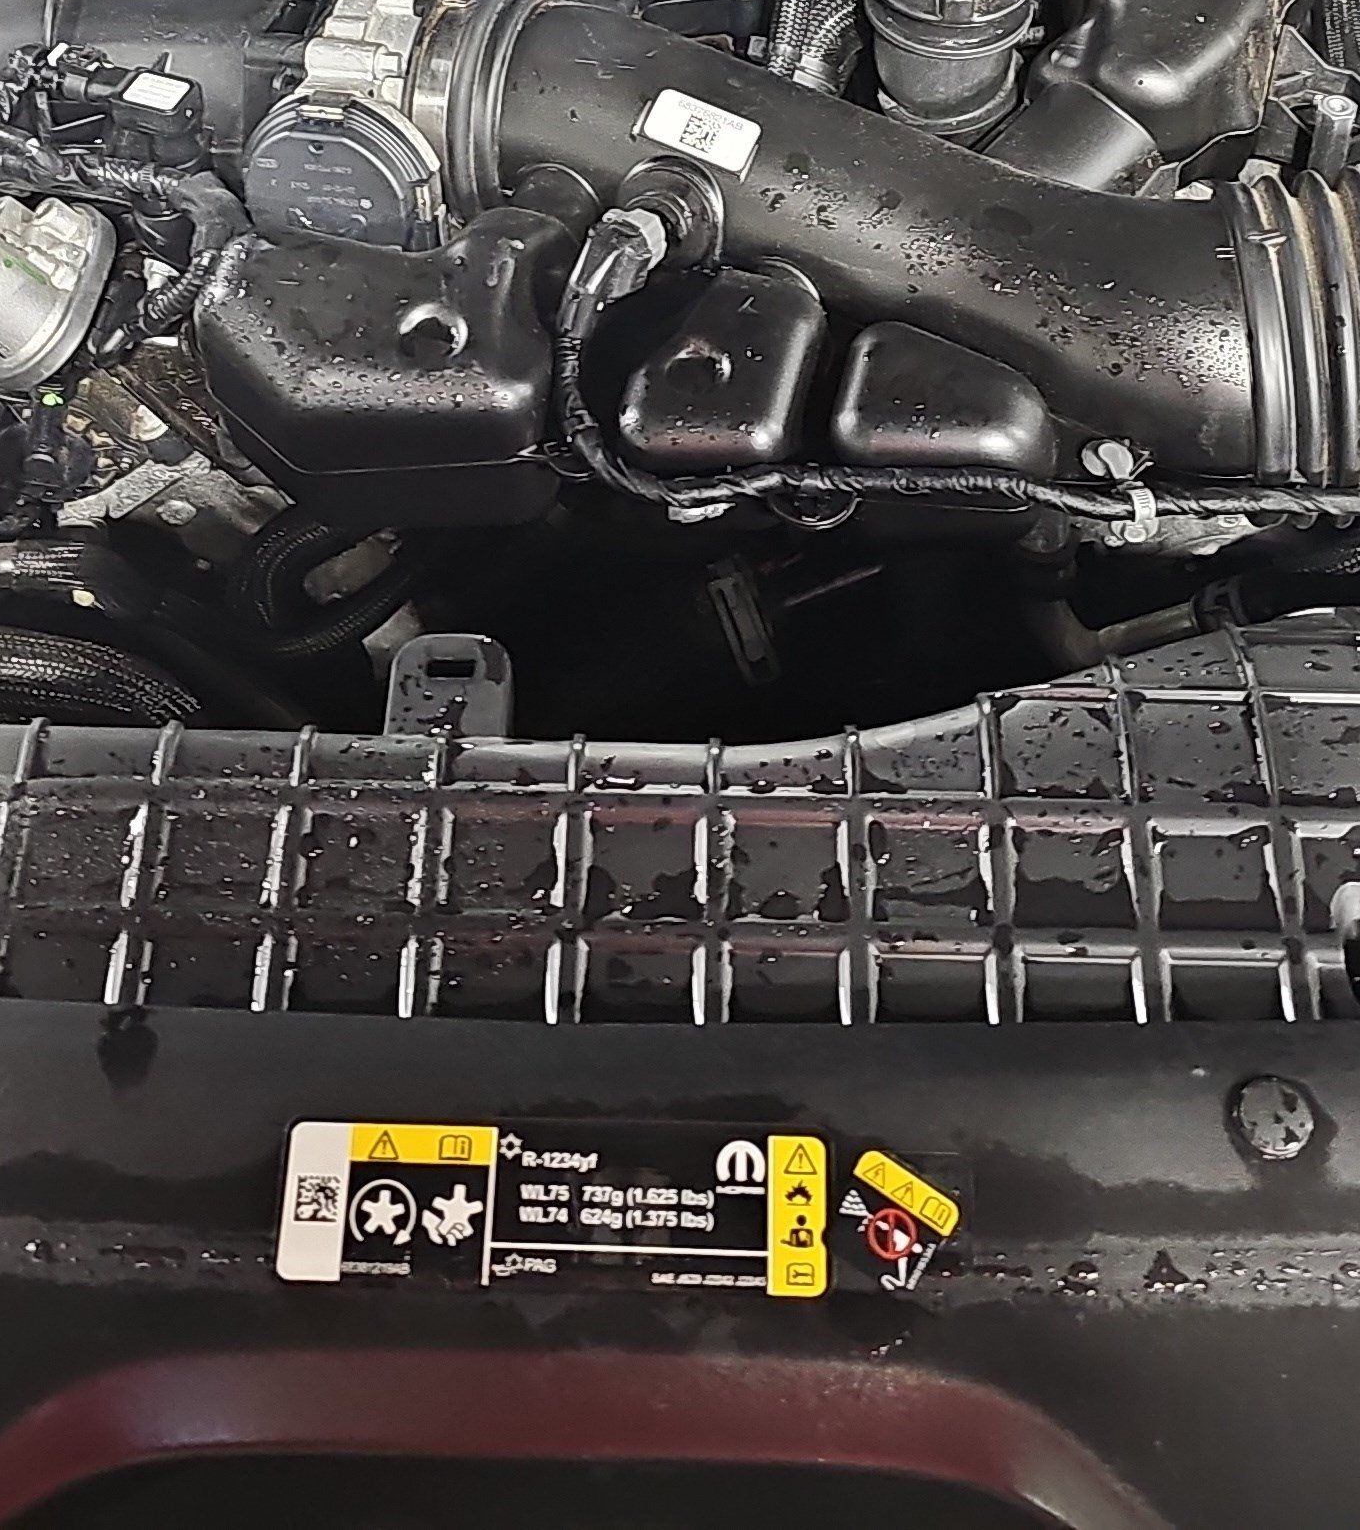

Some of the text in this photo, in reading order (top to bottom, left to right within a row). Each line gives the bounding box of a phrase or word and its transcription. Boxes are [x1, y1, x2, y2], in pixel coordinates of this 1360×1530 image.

[519, 1183, 570, 1202] WL75
[581, 1185, 625, 1207] 737g
[626, 1187, 679, 1207] (1.625
[680, 1188, 715, 1210] lbs)
[518, 1205, 569, 1224] WL74
[579, 1207, 623, 1230] 624g
[680, 1211, 715, 1232] lbs)
